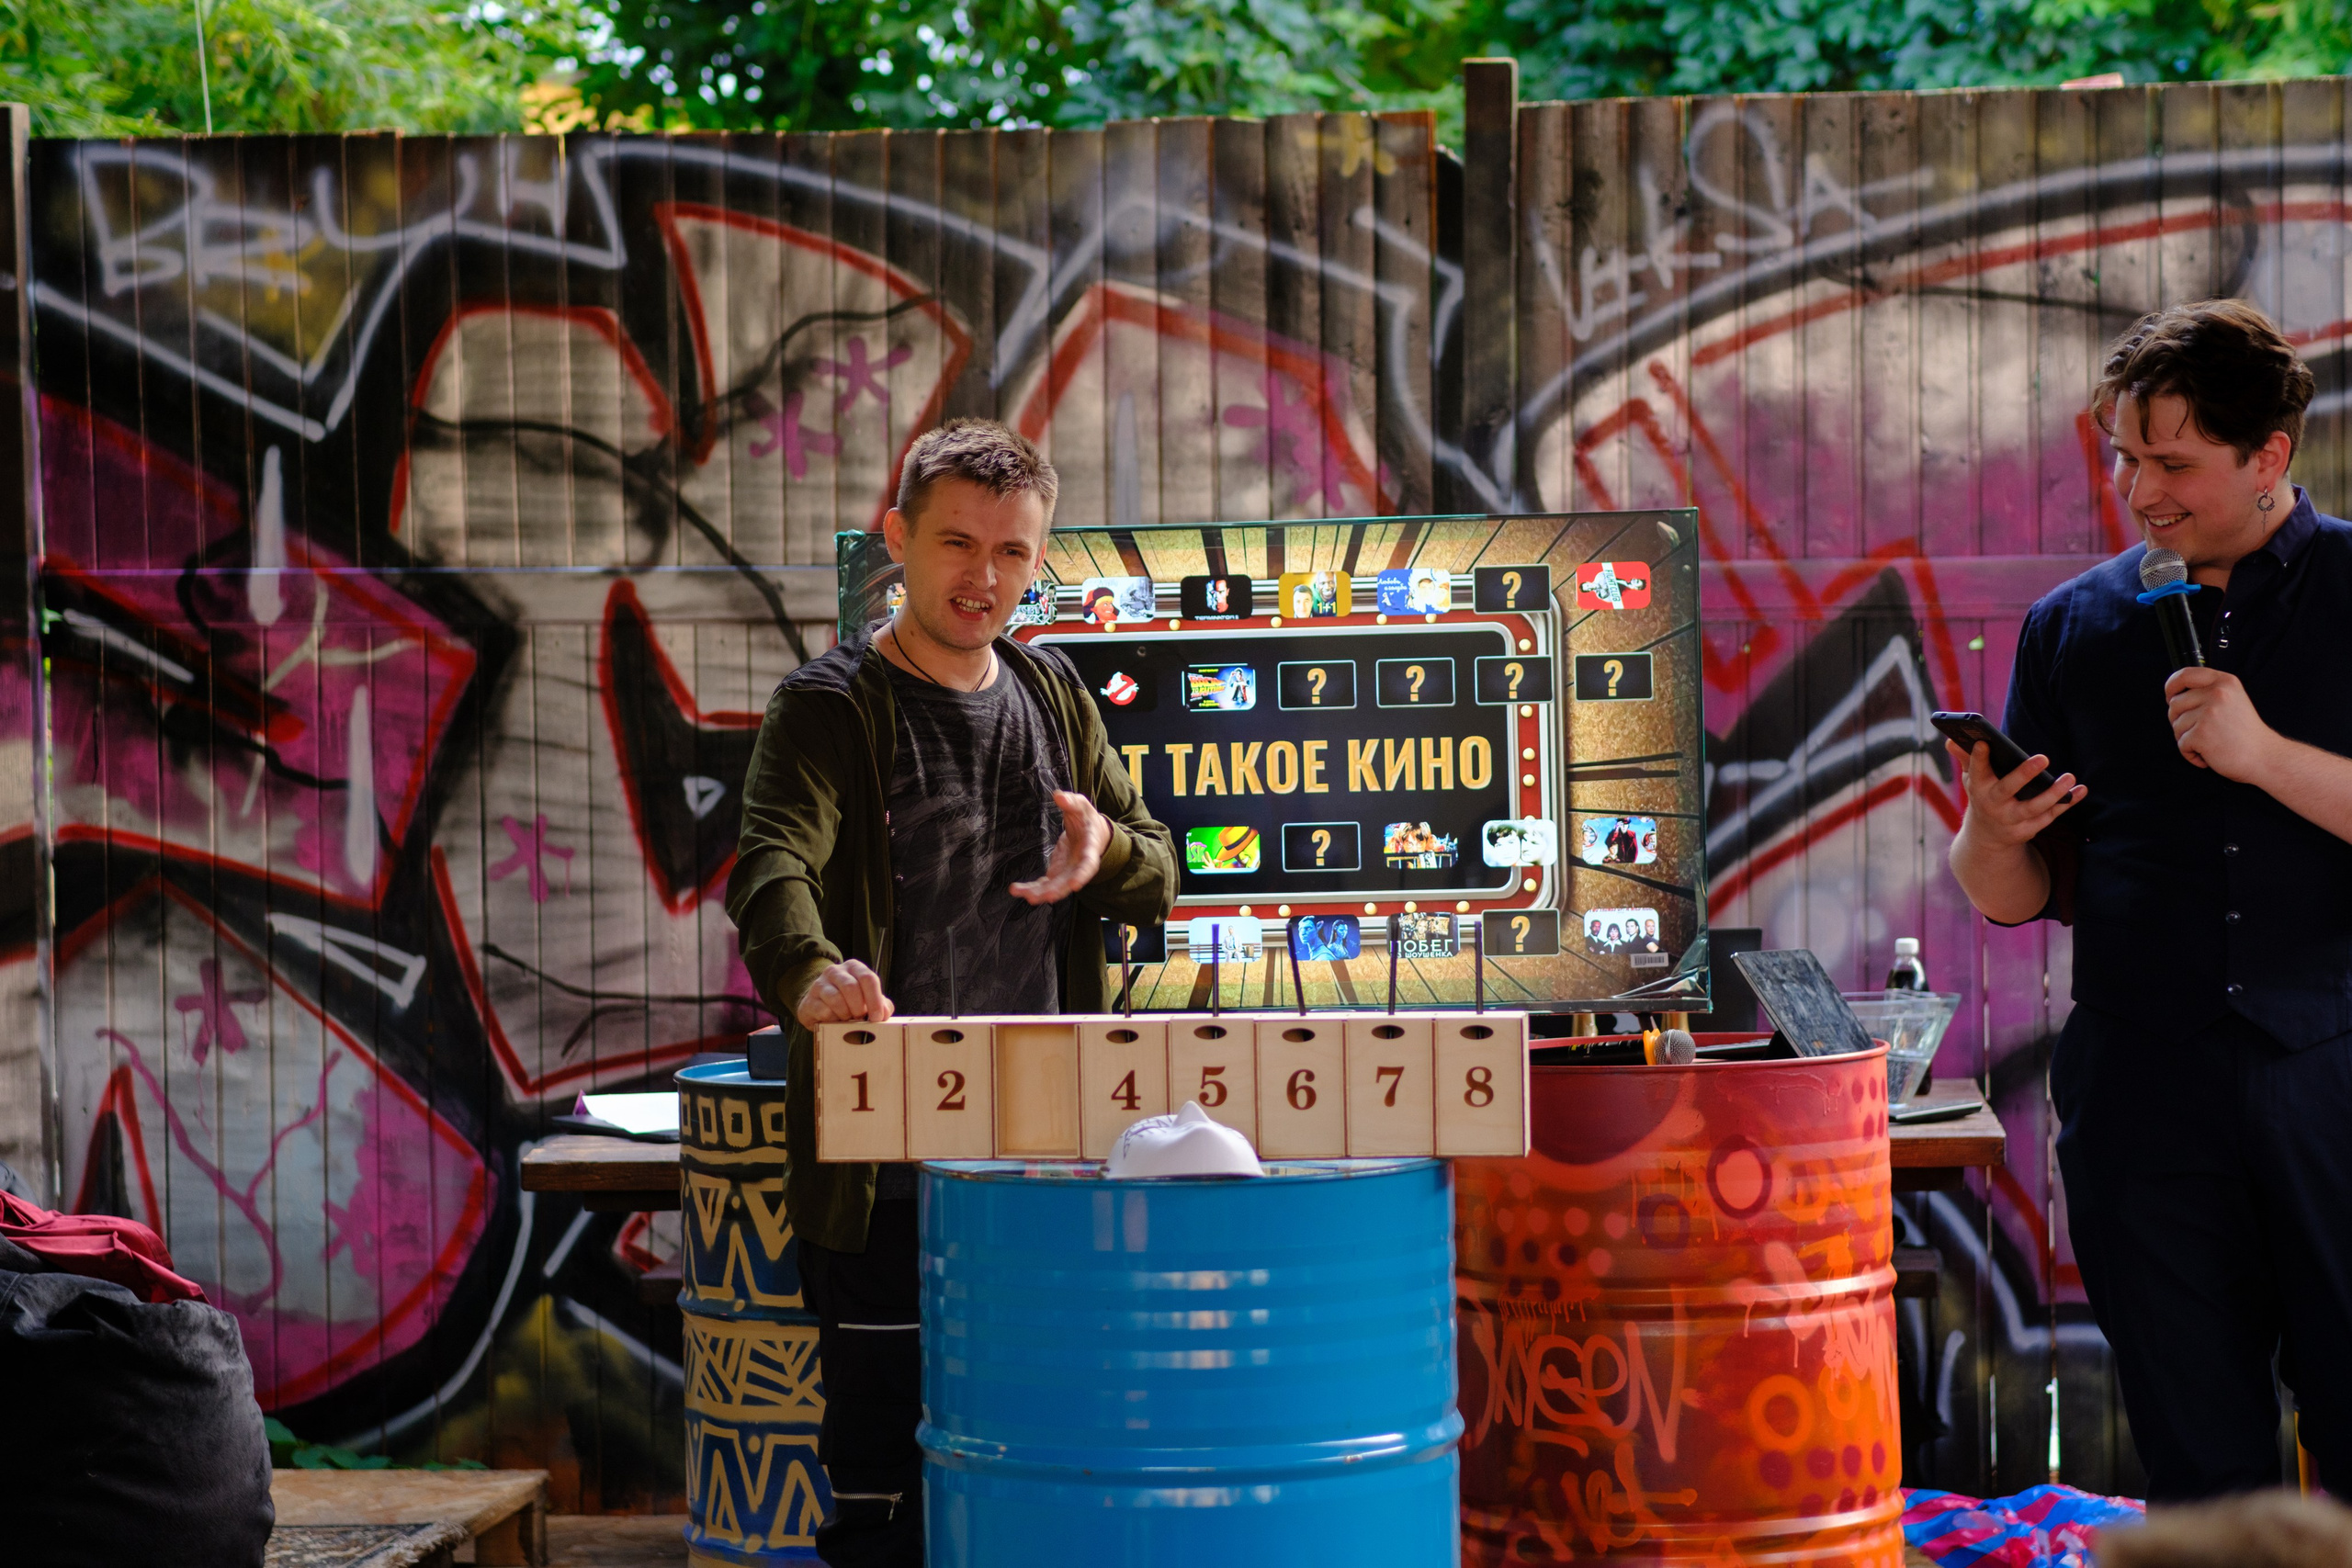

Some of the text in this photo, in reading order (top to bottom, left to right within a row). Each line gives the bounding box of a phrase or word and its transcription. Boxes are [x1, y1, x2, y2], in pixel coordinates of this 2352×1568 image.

[1317, 601, 1337, 614] 1+1
[1501, 570, 1522, 609] ?
[1609, 586, 1621, 602] CLUB
[1306, 667, 1328, 705] ?
[1405, 665, 1426, 702] ?
[1504, 662, 1525, 699] ?
[1603, 659, 1624, 697] ?
[1165, 739, 1329, 796] ТАКОЕ
[1347, 735, 1493, 792] КИНО
[1311, 829, 1331, 867] ?
[1510, 915, 1531, 953] ?
[850, 1066, 1495, 1111] 1 2 4 5 6 7 8
